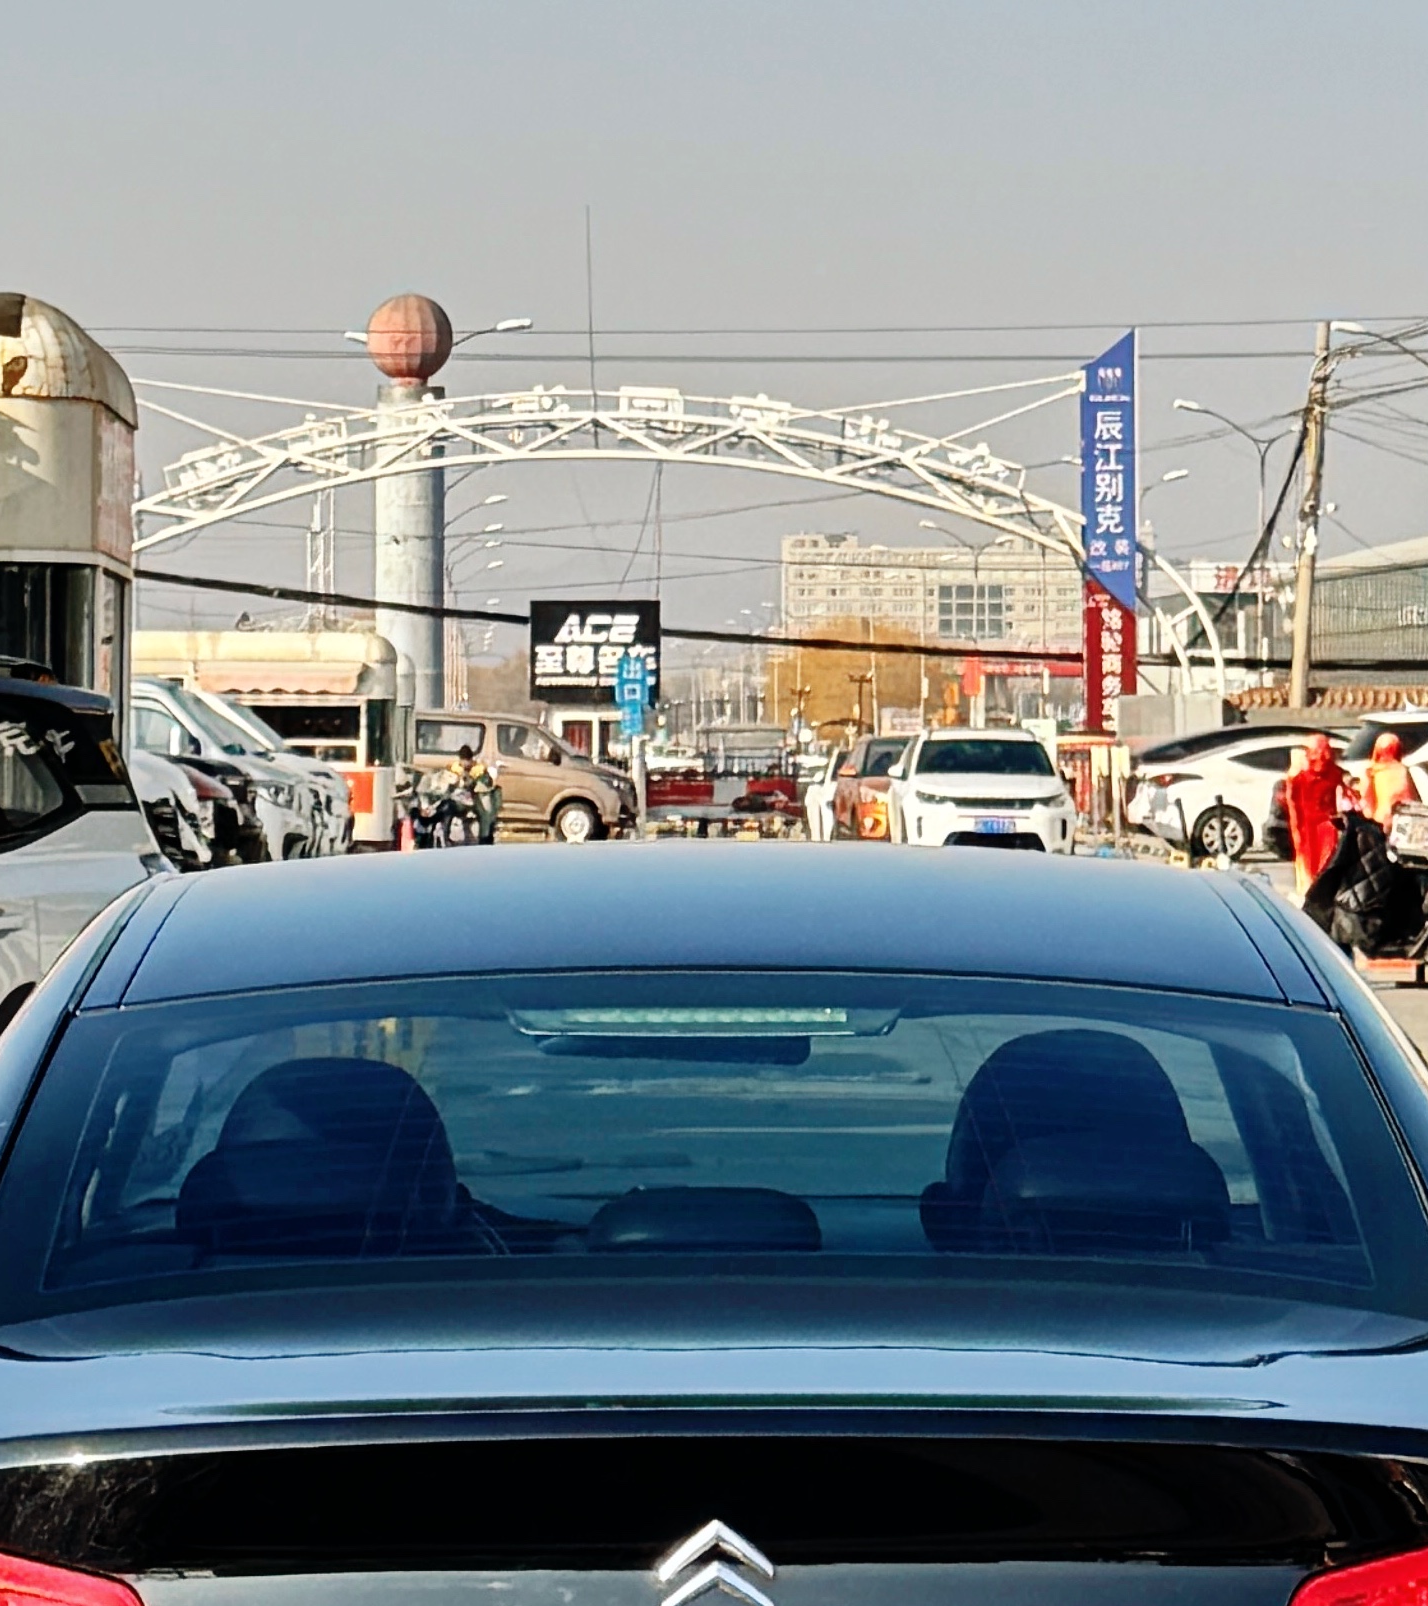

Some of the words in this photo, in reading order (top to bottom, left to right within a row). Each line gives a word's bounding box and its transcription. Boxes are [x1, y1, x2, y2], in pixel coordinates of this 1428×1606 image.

[1094, 411, 1124, 534] 辰江别克
[553, 613, 640, 643] ACE
